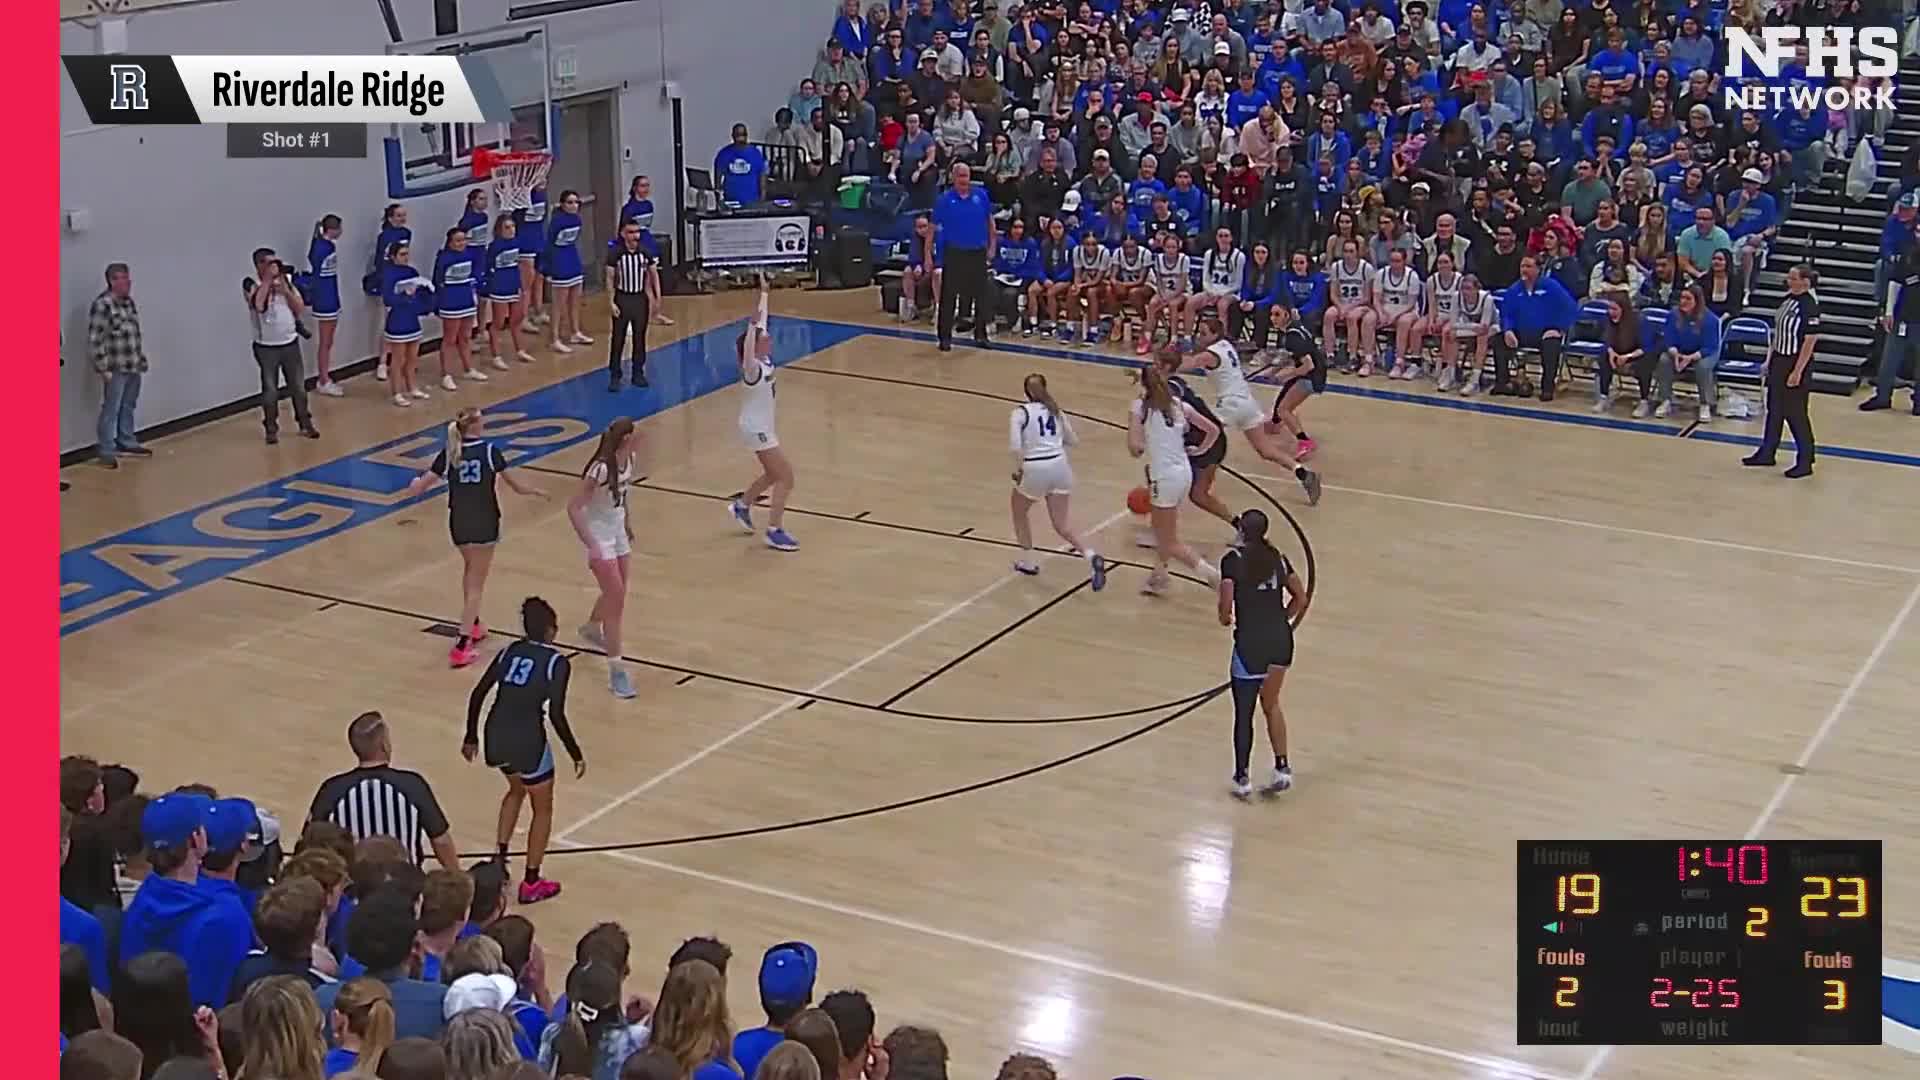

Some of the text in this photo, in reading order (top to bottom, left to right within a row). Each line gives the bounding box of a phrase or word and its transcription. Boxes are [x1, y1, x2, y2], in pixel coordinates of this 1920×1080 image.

[1037, 415, 1057, 437] 14
[459, 459, 481, 483] 23
[504, 656, 534, 685] 13
